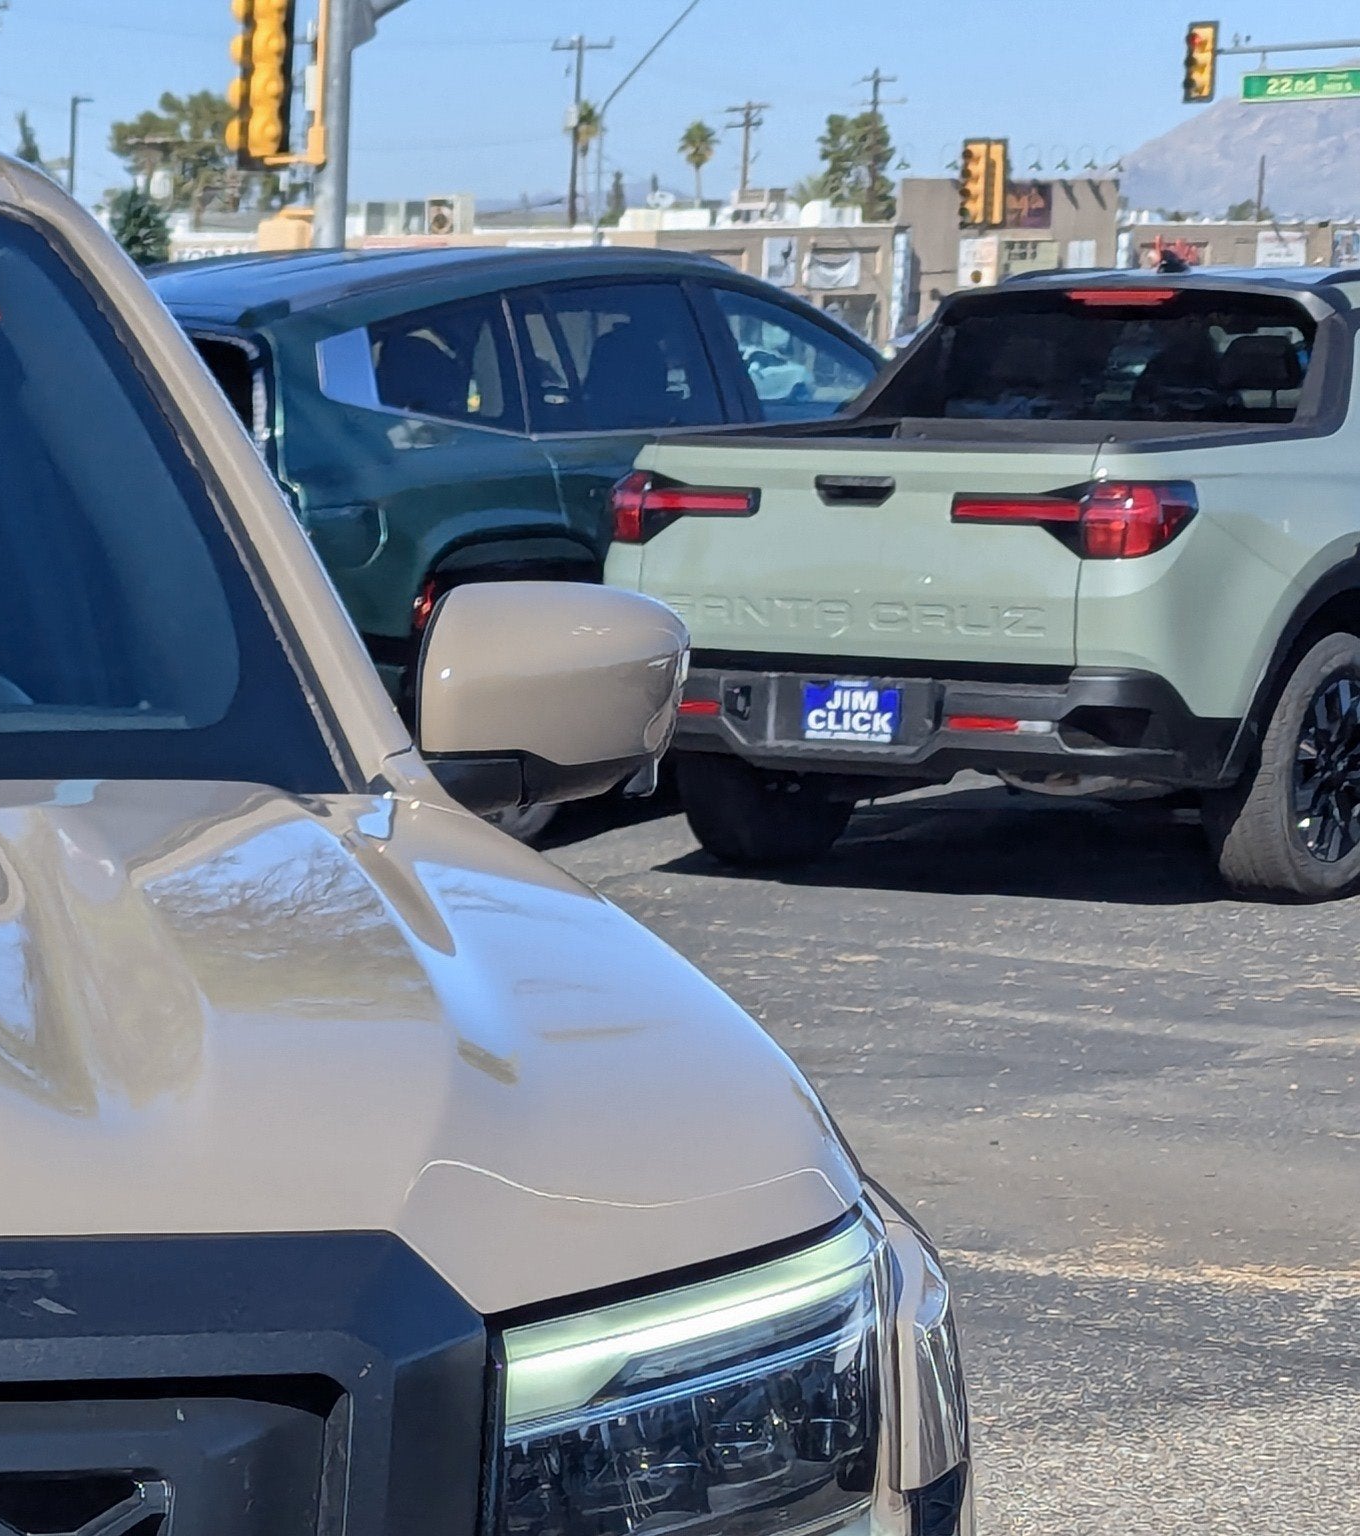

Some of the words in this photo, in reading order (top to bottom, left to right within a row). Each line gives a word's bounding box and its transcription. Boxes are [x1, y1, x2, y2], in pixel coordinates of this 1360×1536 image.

[868, 600, 1046, 637] CRUZ
[826, 689, 879, 711] JIM
[807, 708, 893, 734] CLICK
